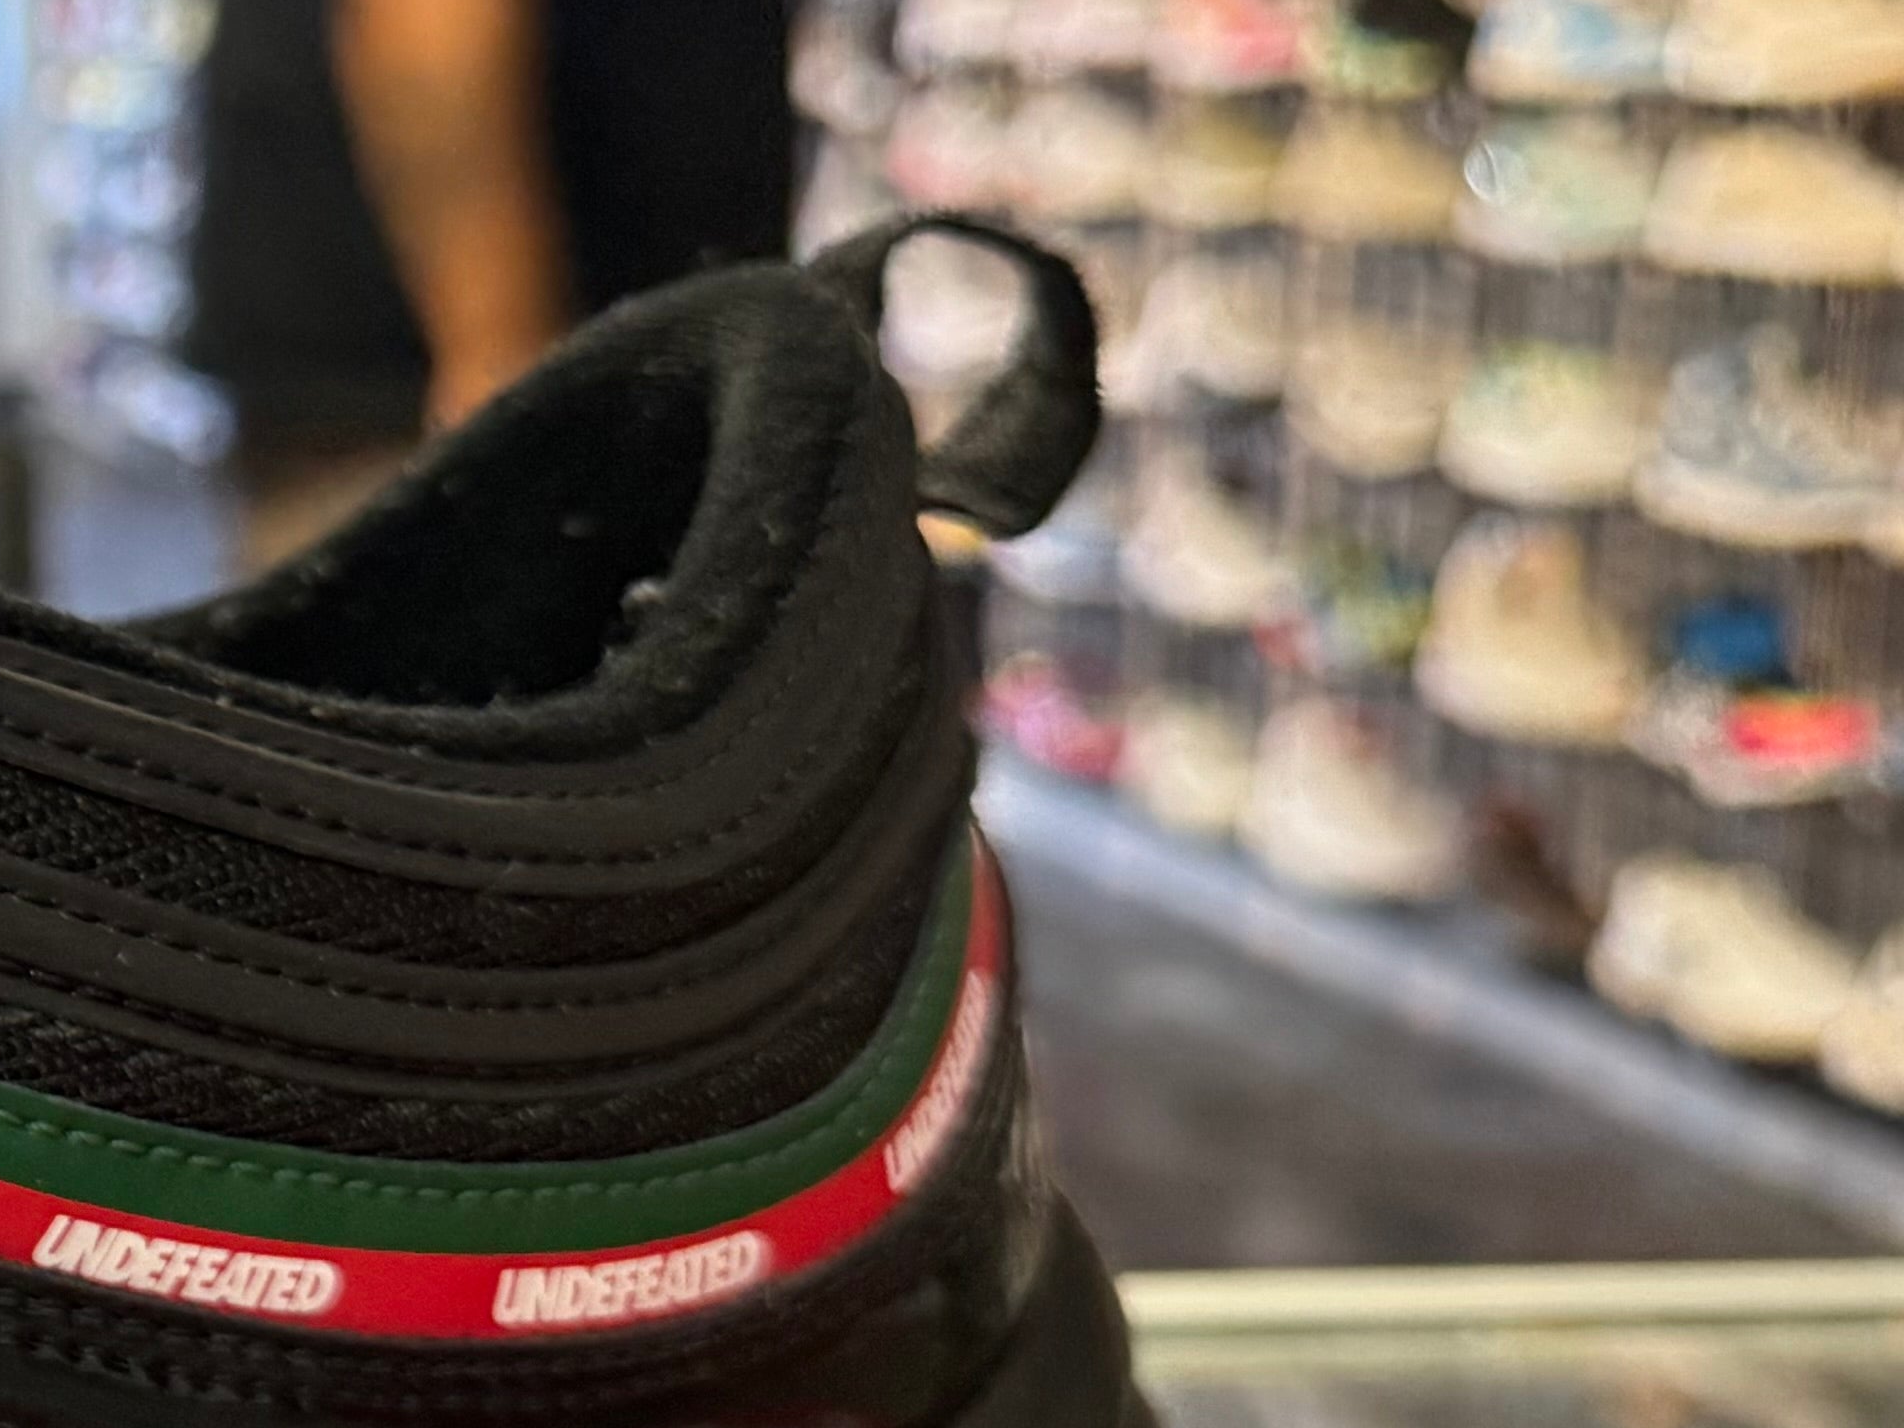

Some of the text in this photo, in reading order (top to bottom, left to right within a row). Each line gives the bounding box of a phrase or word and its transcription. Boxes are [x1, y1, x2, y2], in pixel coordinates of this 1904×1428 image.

[883, 968, 991, 1193] UNDEFE
[34, 1215, 341, 1315] UNDEFEATED
[493, 1231, 769, 1326] UNDEFEATED
